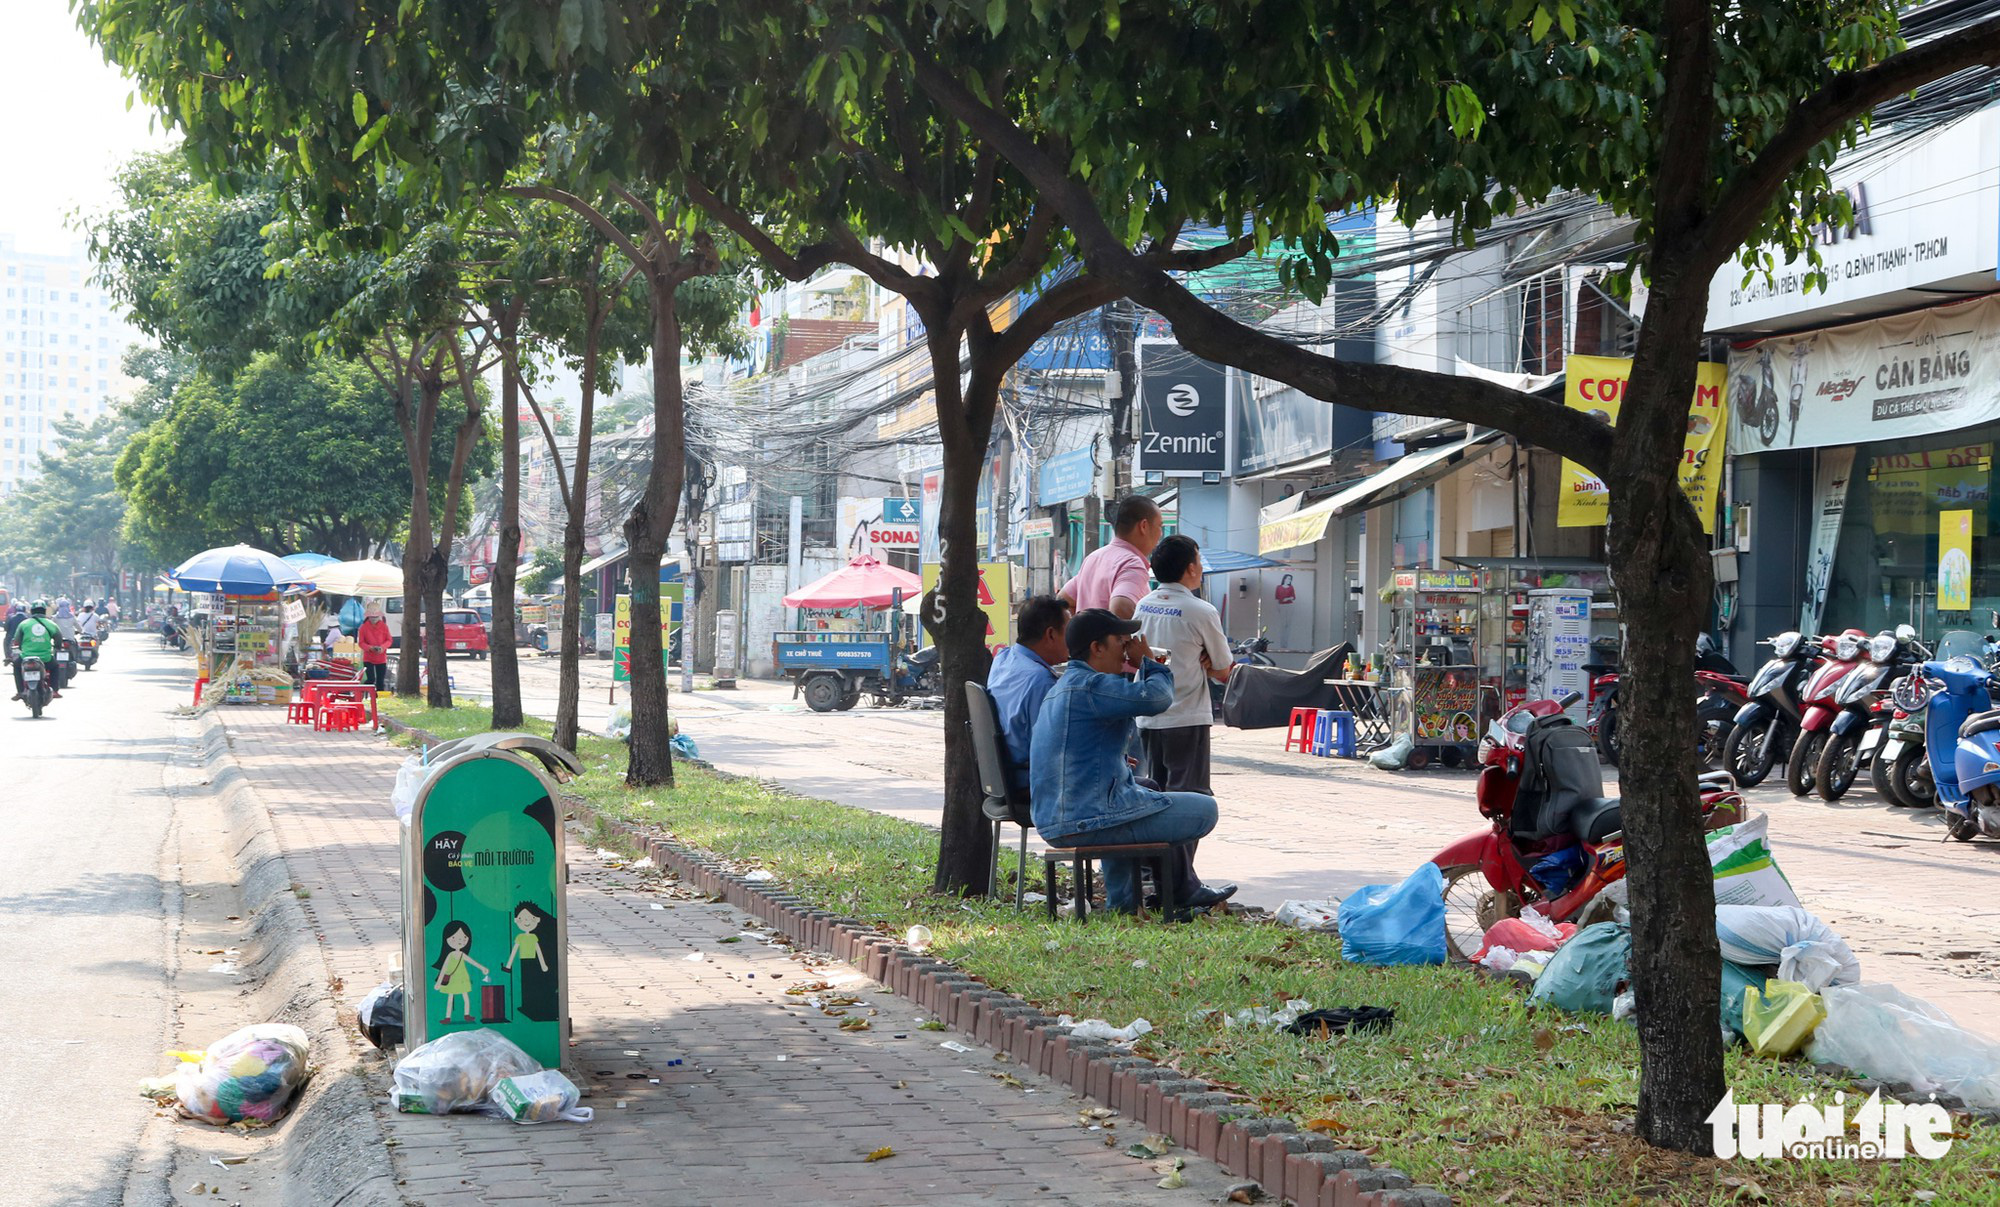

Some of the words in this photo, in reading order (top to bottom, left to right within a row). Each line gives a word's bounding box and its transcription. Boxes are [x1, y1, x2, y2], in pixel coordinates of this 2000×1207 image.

[1845, 254, 1875, 279] Q.BÌNH
[1876, 247, 1907, 272] THẠNH
[1914, 237, 1948, 262] TP.HCM
[1875, 355, 1915, 391] CÂN
[1919, 345, 1971, 385] BẰNG
[1144, 431, 1218, 454] Zennic
[1139, 604, 1164, 615] PIAGGIO
[1164, 608, 1182, 617] SAPA
[435, 838, 458, 849] HÃY
[474, 848, 494, 867] MÔI
[496, 847, 534, 867] TRƯỜNG
